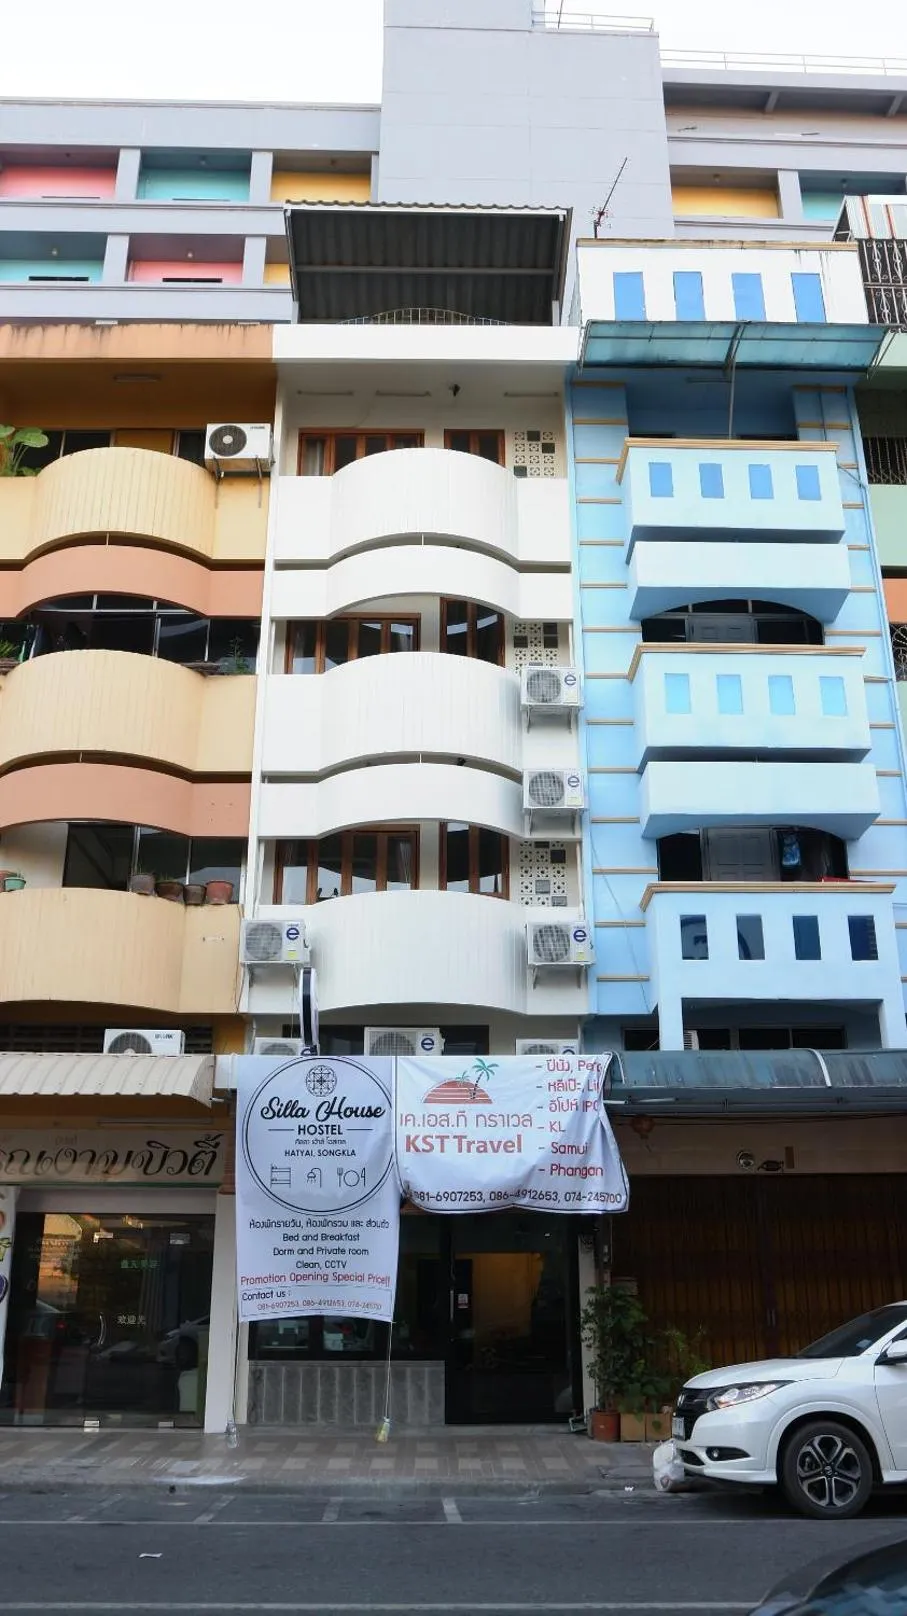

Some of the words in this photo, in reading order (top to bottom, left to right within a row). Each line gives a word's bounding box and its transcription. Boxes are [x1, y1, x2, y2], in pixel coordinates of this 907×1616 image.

[260, 1096, 310, 1120] Silla
[315, 1096, 386, 1122] House
[400, 1110, 467, 1128] เค.เอส.ที
[475, 1112, 532, 1128] ทราเวล
[297, 1124, 343, 1136] HOSTEL
[549, 1120, 566, 1133] KL
[405, 1134, 450, 1154] KST
[453, 1133, 522, 1154] Travel
[551, 1141, 588, 1155] Samui
[284, 1149, 316, 1158] HATYAI,
[317, 1149, 356, 1157] SONGKLA
[550, 1163, 604, 1180] Phangan
[489, 1191, 561, 1205] 086-4912653,
[563, 1193, 622, 1205] 074-245700
[350, 1219, 364, 1228] และ
[282, 1233, 300, 1242] Bed
[301, 1233, 318, 1242] and
[320, 1233, 360, 1242] Breakfast
[273, 1247, 295, 1256] Dorm
[297, 1247, 314, 1256] and
[316, 1247, 346, 1256] Private
[348, 1248, 369, 1256] room
[295, 1260, 322, 1270] Clean,
[324, 1260, 347, 1269] CCTV
[240, 1273, 286, 1286] Promotion
[289, 1272, 329, 1283] Opening
[332, 1272, 365, 1283] Special
[242, 1290, 274, 1301] Contact
